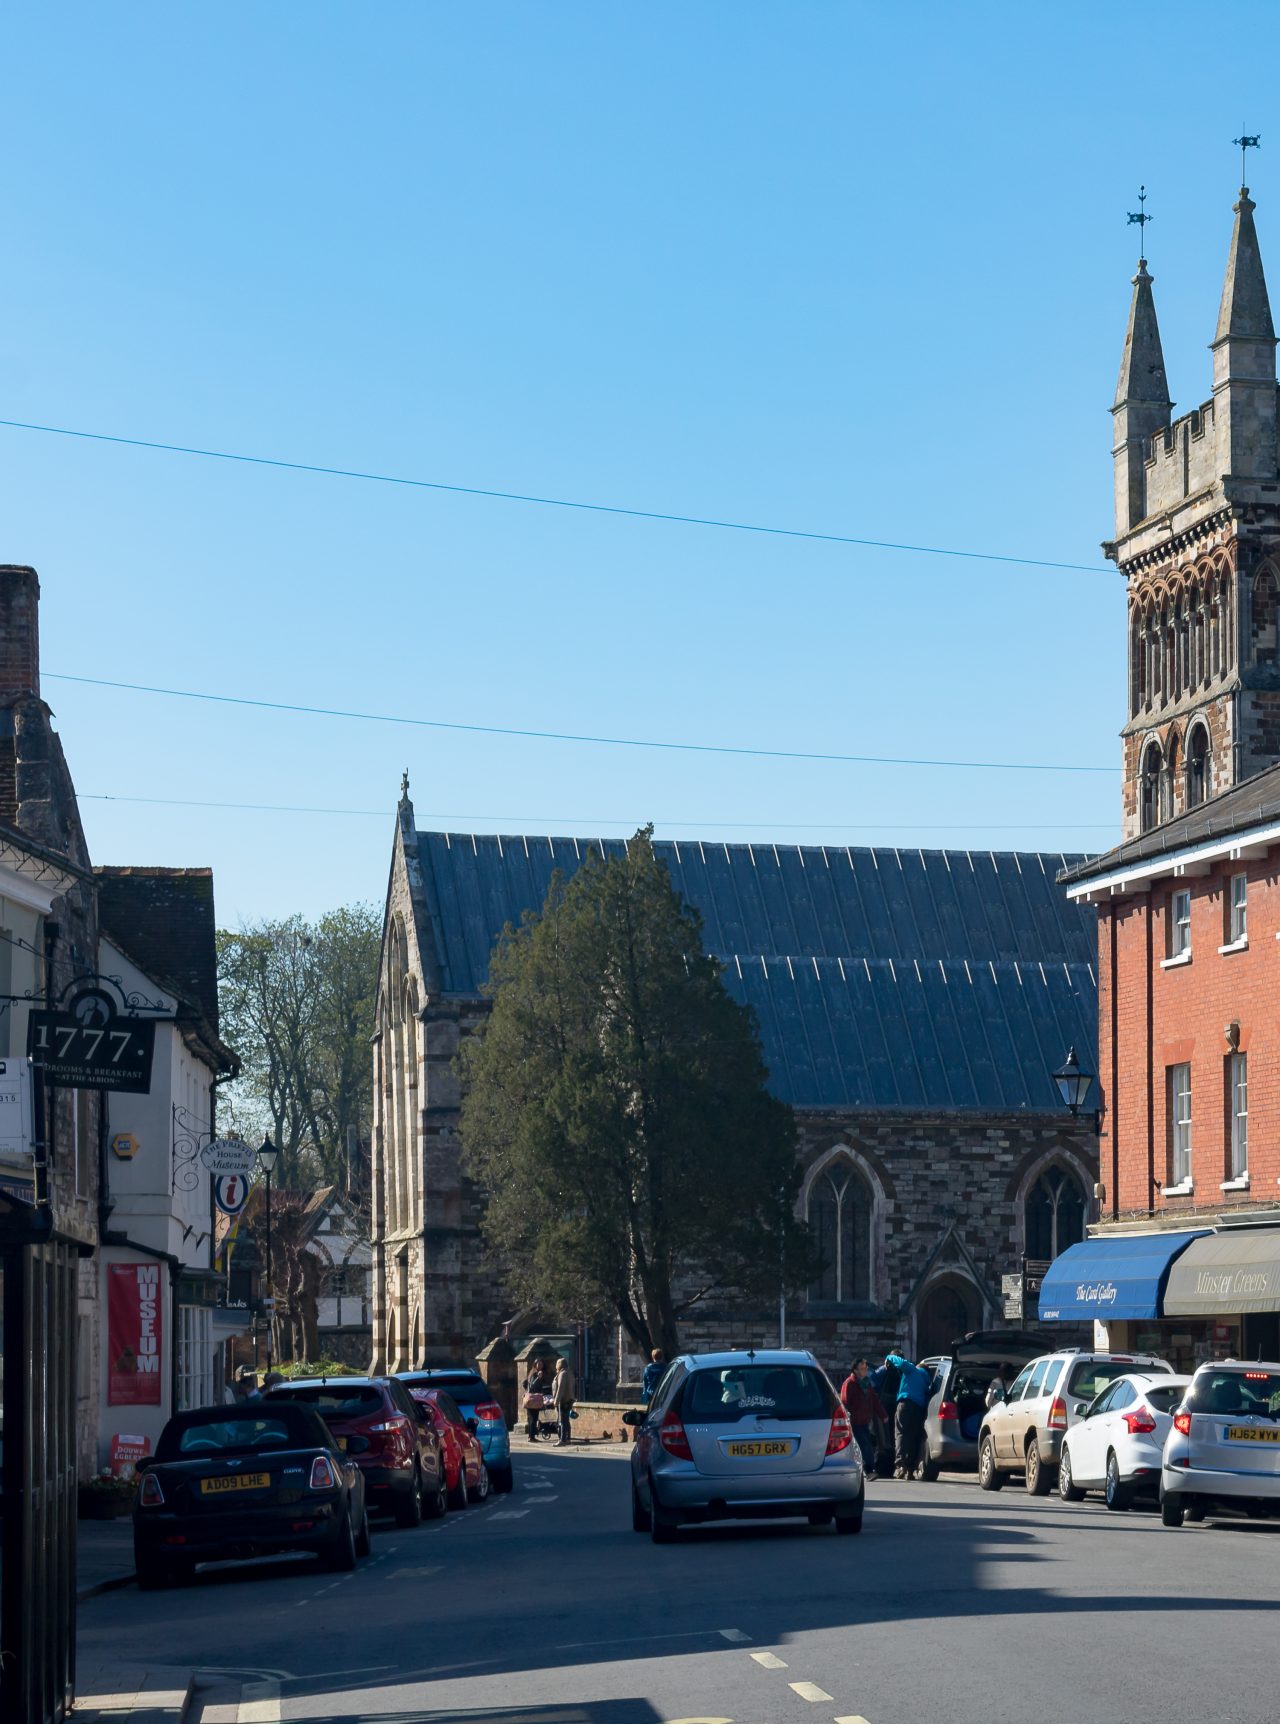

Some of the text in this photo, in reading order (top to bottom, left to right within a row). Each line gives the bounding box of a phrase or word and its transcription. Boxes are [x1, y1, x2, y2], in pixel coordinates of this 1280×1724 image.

[44, 1063, 143, 1079] DROOMS & BREAKFAST
[88, 1076, 115, 1084] ALBION
[1194, 1269, 1268, 1294] Minster Greens
[1085, 1283, 1100, 1302] Card
[1097, 1282, 1117, 1304] Gallery
[137, 1265, 159, 1373] MUSEUM
[1230, 1429, 1256, 1440] HJ62
[114, 1452, 142, 1461] EGBERT
[732, 1443, 786, 1455] HG57 GRX
[206, 1475, 264, 1491] AD09 LHE
